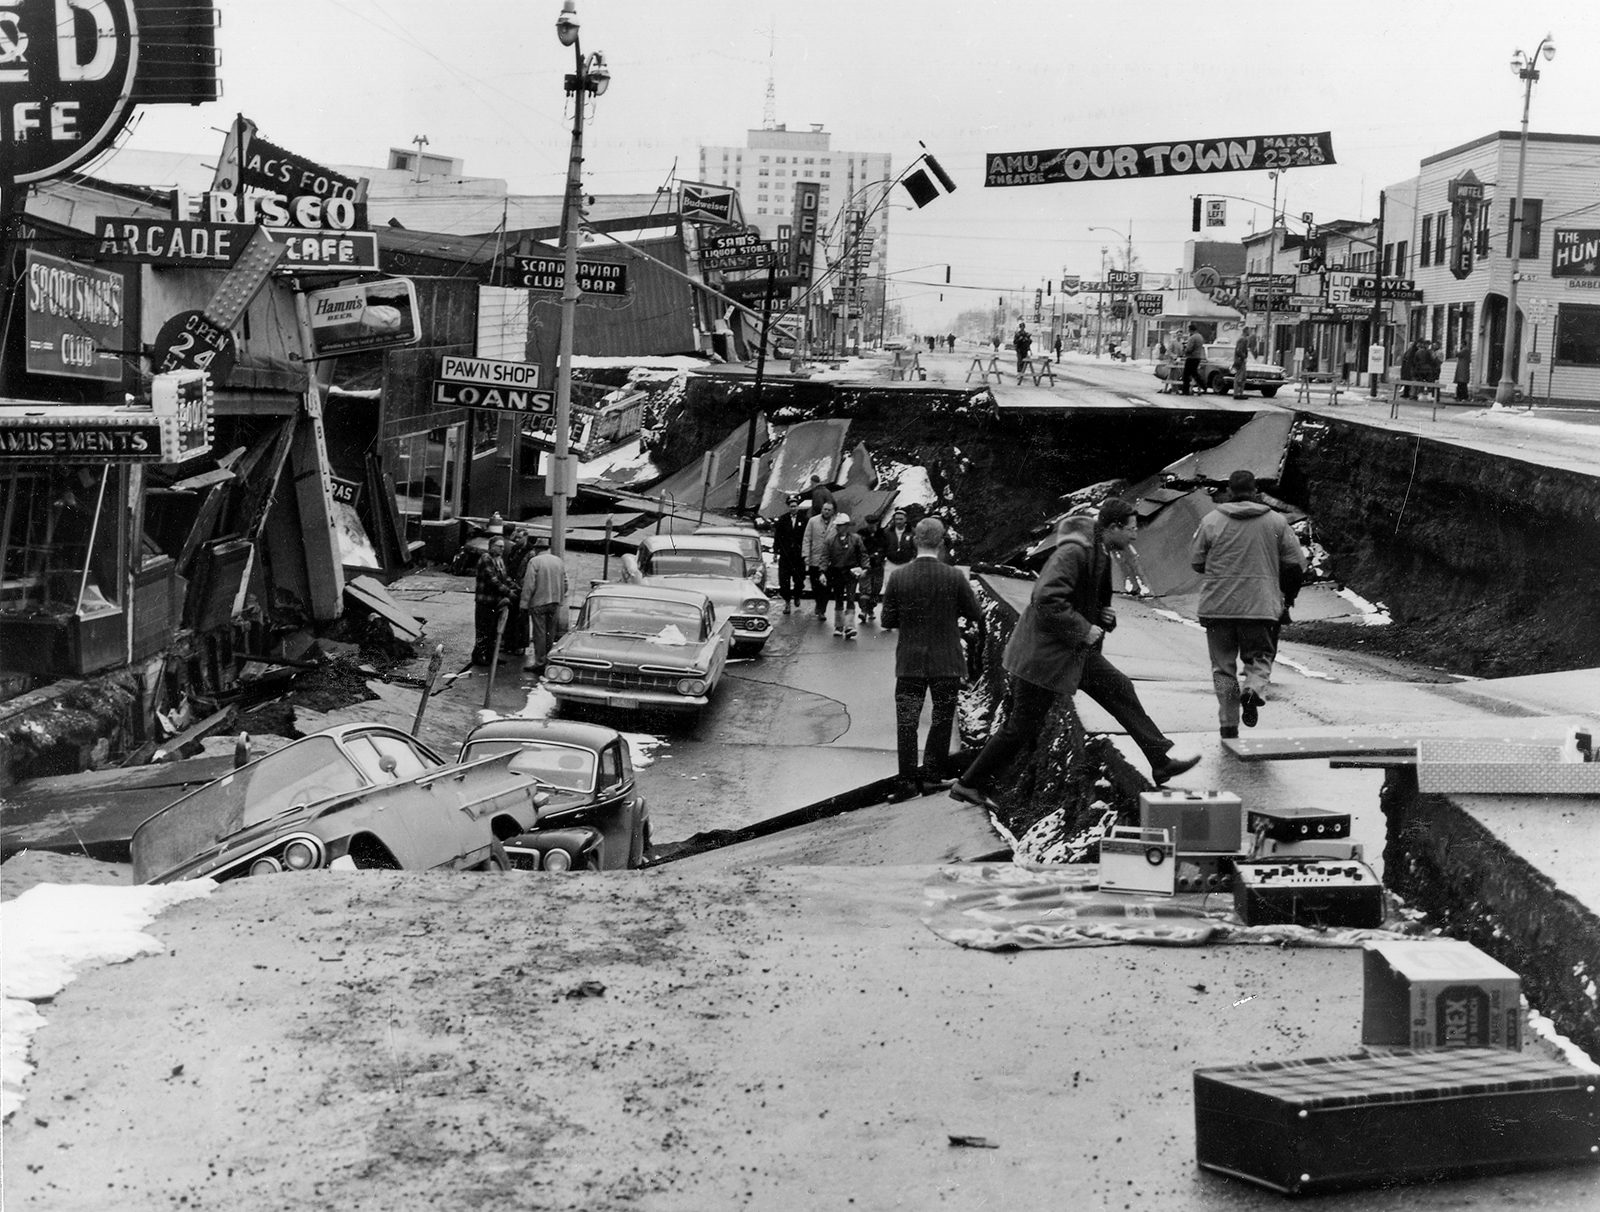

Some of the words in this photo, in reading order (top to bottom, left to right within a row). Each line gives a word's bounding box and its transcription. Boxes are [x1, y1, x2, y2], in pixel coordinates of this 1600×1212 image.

[0, 102, 81, 141] FE
[1263, 136, 1318, 149] MARCH
[990, 155, 1038, 174] AMU
[1064, 146, 1138, 180] OUR
[1145, 139, 1256, 174] TOWN
[239, 153, 293, 182] AC'S
[300, 171, 357, 203] FOTO
[988, 172, 1046, 185] THEATRE
[177, 186, 356, 230] FRISCO
[684, 196, 729, 212] Budweiser
[1208, 210, 1224, 218] LEFT
[100, 222, 232, 262] ARCADE
[717, 234, 756, 249] SAM'S
[1557, 232, 1580, 244] THE
[286, 237, 355, 263] CAFE
[704, 247, 737, 259] LIQUOR
[740, 244, 768, 255] STORE
[1556, 239, 1600, 268] HUN
[521, 260, 620, 278] SCANDAVIAN
[1109, 273, 1137, 282] FURS
[523, 274, 564, 288] CLUB
[582, 278, 616, 292] BAR
[1200, 273, 1215, 286] 76
[1569, 280, 1600, 289] BARBE
[30, 263, 121, 328] SPORTSMAN'S
[1356, 290, 1387, 298] LIQUR
[1391, 291, 1416, 299] STORE
[314, 294, 363, 316] Hamm's
[326, 312, 353, 322] BEER
[185, 314, 229, 352] OPEN
[61, 333, 94, 367] CLUB
[168, 331, 217, 371] 24
[445, 359, 490, 381] PAWN
[493, 363, 537, 386] SHOP
[437, 384, 551, 412] LOANS
[0, 431, 149, 451] MUSEMENTS
